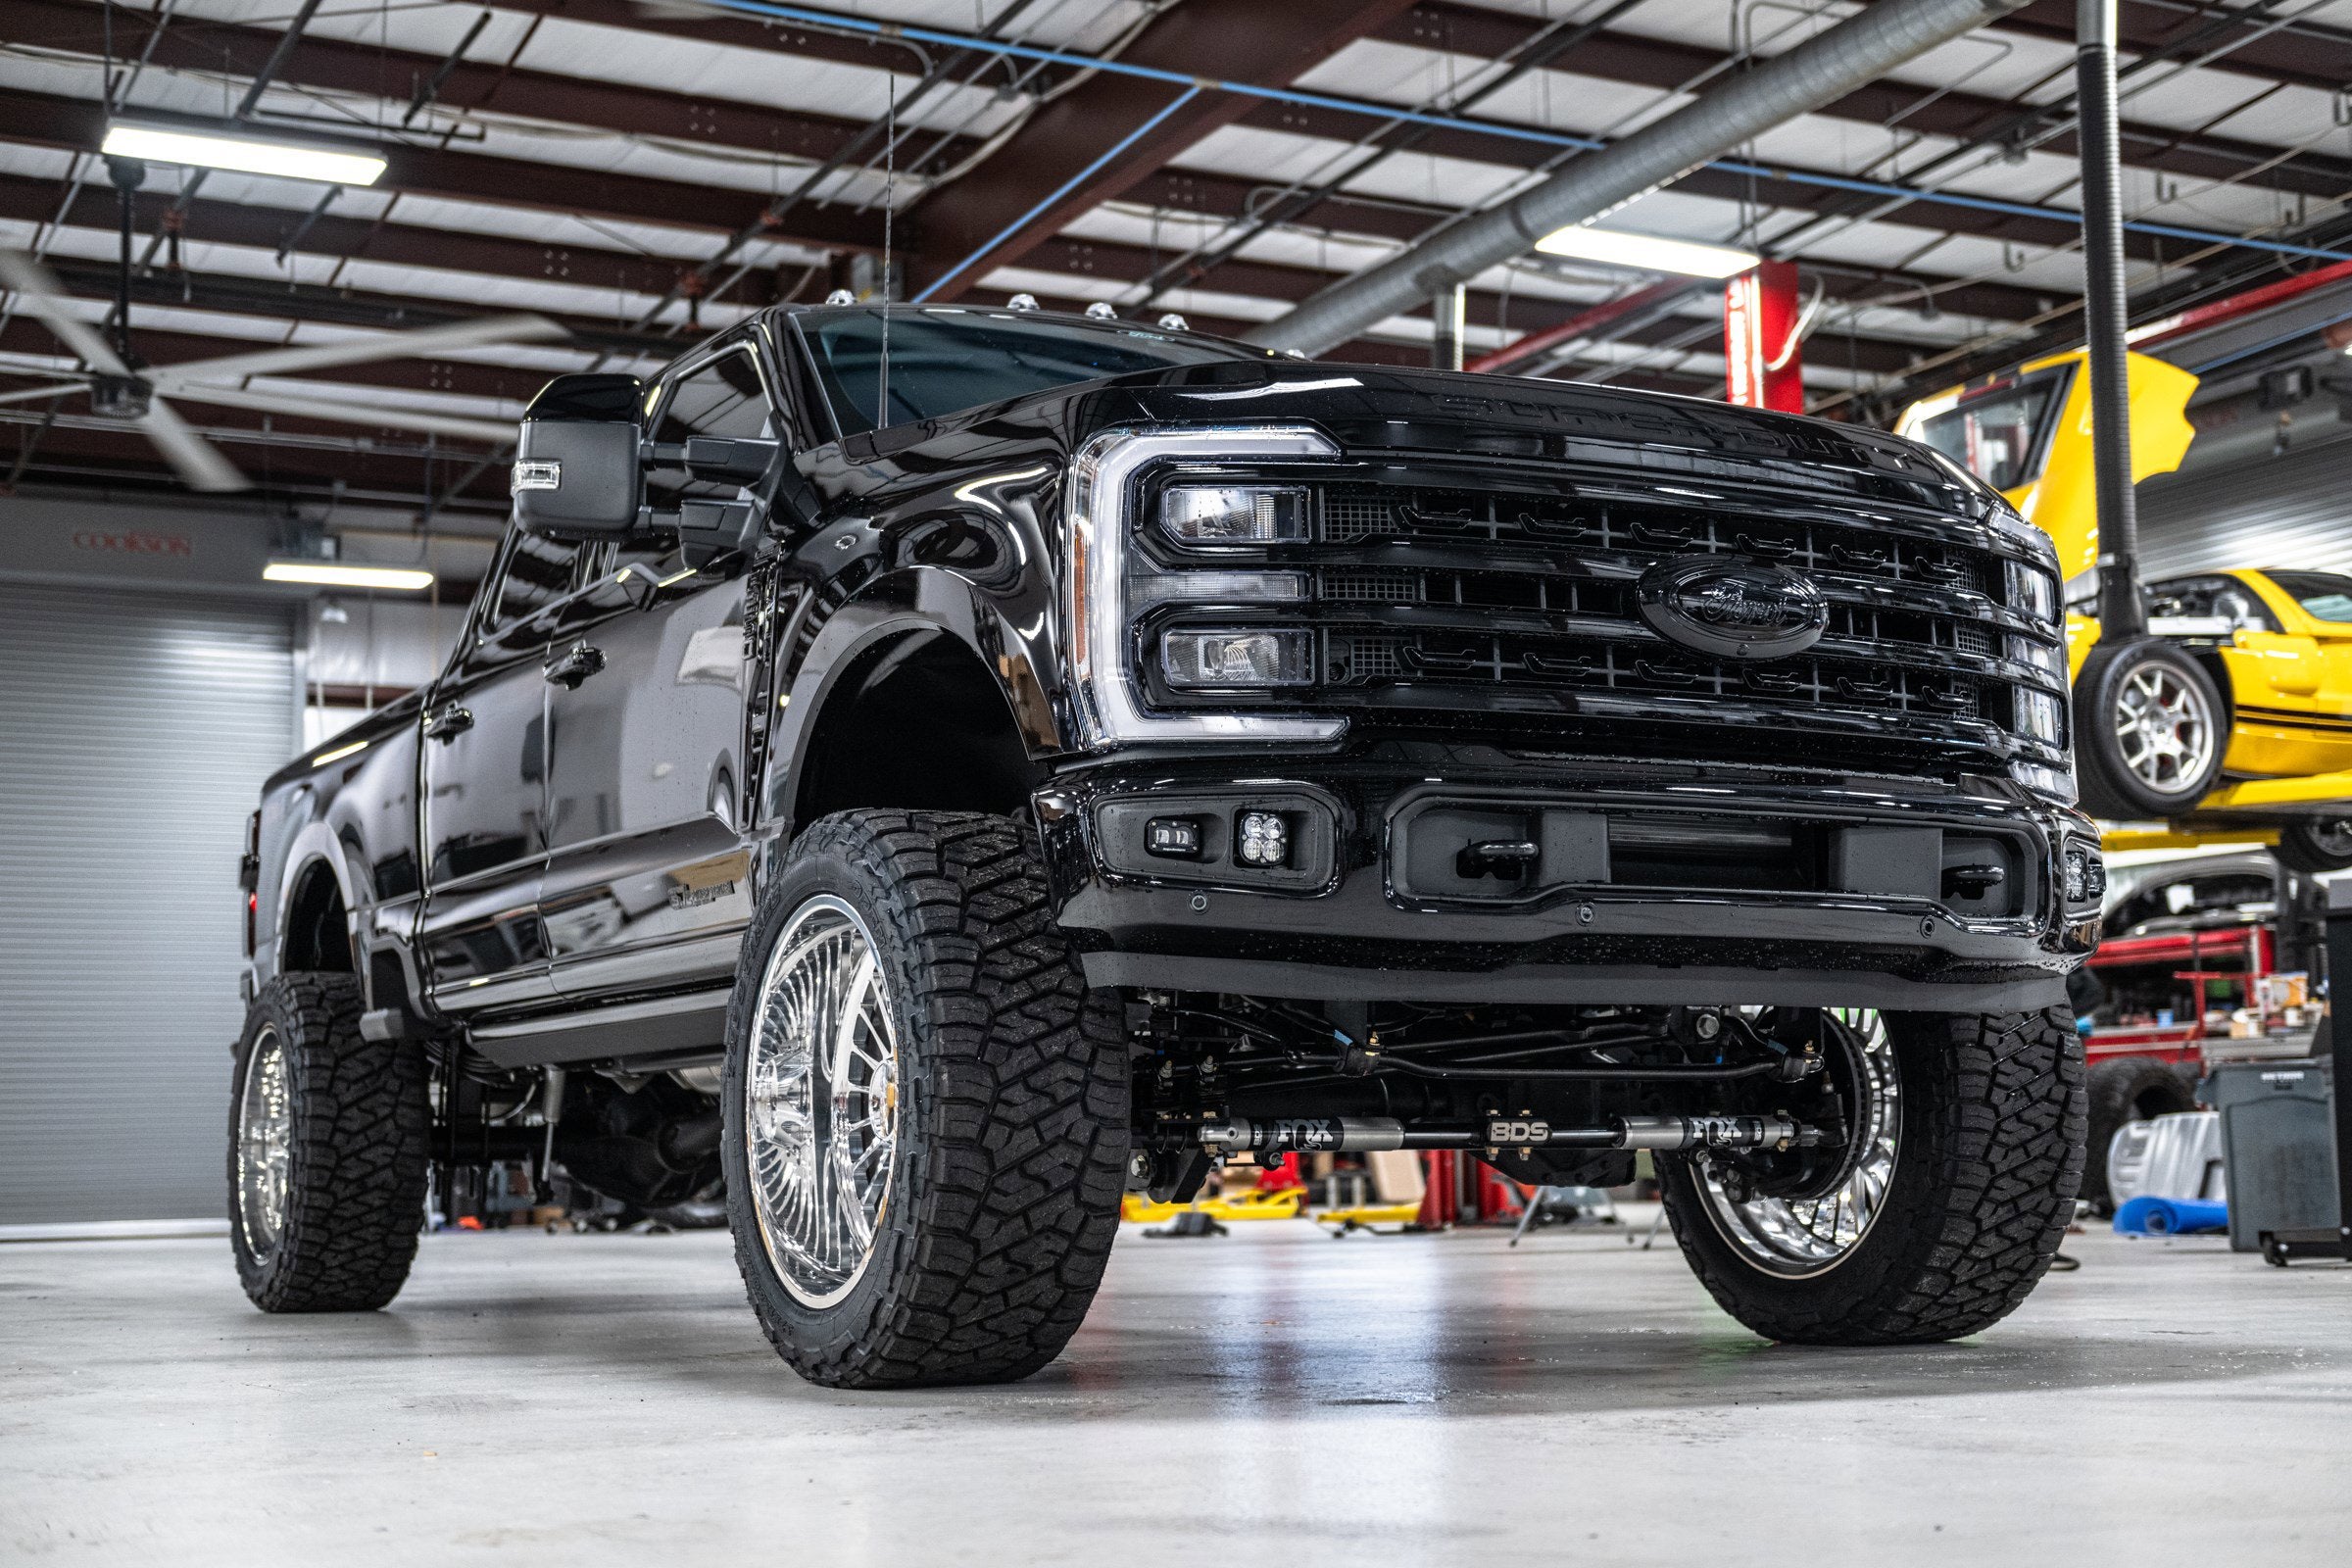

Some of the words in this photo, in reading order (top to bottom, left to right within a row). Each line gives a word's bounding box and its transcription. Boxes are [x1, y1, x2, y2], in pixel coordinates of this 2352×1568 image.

[1702, 582, 1788, 625] Ford
[1275, 1119, 1335, 1151] FOX
[1491, 1122, 1548, 1142] BDS
[1689, 1117, 1742, 1146] FOX
